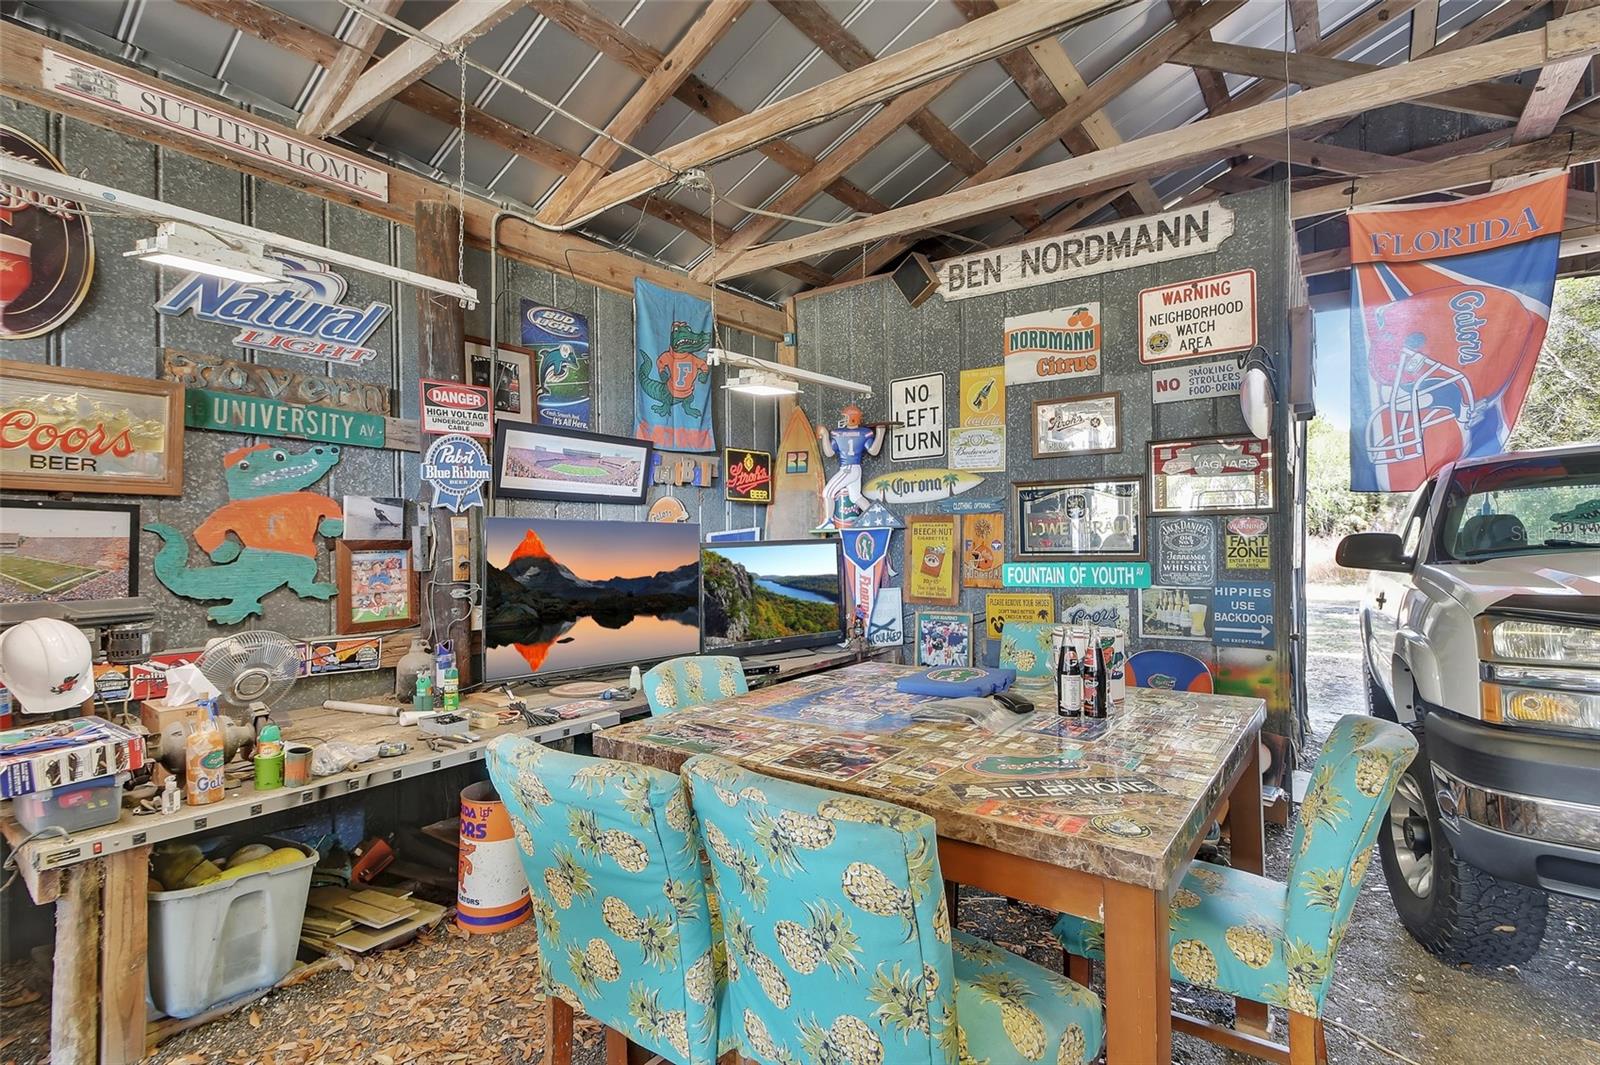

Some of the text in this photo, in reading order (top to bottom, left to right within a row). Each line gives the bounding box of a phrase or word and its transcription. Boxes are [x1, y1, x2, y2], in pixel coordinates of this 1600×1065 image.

[140, 91, 368, 189] SUTTER HOME
[1369, 207, 1544, 257] FLORIDA
[949, 210, 1209, 292] BEN NORDMANN
[1162, 280, 1231, 306] WARNING
[165, 272, 386, 343] Natural
[1149, 300, 1243, 327] NEIGHBORHOOD
[535, 317, 579, 334] LIGHT
[543, 311, 575, 324] BUD
[1176, 320, 1216, 337] WATCH
[1449, 290, 1487, 365] Gators
[241, 330, 374, 363] LIGHT
[1010, 329, 1094, 351] NORDMANN
[1179, 335, 1212, 352] AREA
[1036, 355, 1098, 377] Citrus
[1188, 364, 1234, 378] SMOKING
[1156, 378, 1181, 392] NO
[1188, 372, 1241, 386] STROLLERS
[432, 389, 481, 406] DANGER
[904, 384, 930, 405] NO
[213, 398, 355, 439] UNIVERSITY
[359, 424, 375, 437] AV
[426, 408, 488, 421] HIGH VOLTAGE
[432, 418, 485, 428] UNDERGROUND
[895, 406, 940, 429] LEFT
[448, 424, 470, 432] CABLE
[562, 417, 572, 427] All
[572, 419, 589, 430] Here.
[0, 409, 135, 458] Coors
[894, 430, 942, 452] TURN
[440, 444, 475, 465] Pabst
[846, 438, 855, 456] 1
[30, 454, 97, 472] BEER
[425, 465, 490, 480] Blue Ribbon
[750, 489, 768, 499] BEER
[891, 477, 943, 498] Corona
[1162, 520, 1210, 536] JACK DANIEL'S
[1230, 523, 1266, 531] WARNING
[1230, 536, 1268, 547] FART
[1166, 551, 1206, 561] Tennessee
[1227, 547, 1269, 558] ZONE
[1007, 565, 1066, 585] FOUNTAIN
[1070, 565, 1087, 585] OF
[1091, 566, 1135, 585] YOUTH
[1136, 567, 1144, 576] AV
[1162, 564, 1210, 572] WHISKEY
[1214, 586, 1273, 598] HIPPIES
[1230, 601, 1256, 611] USE
[1070, 607, 1120, 625] Coors
[1214, 612, 1275, 625] BACKDOOR
[993, 780, 1151, 799] TELEPHONE
[1026, 777, 1101, 786] PUBLIC
